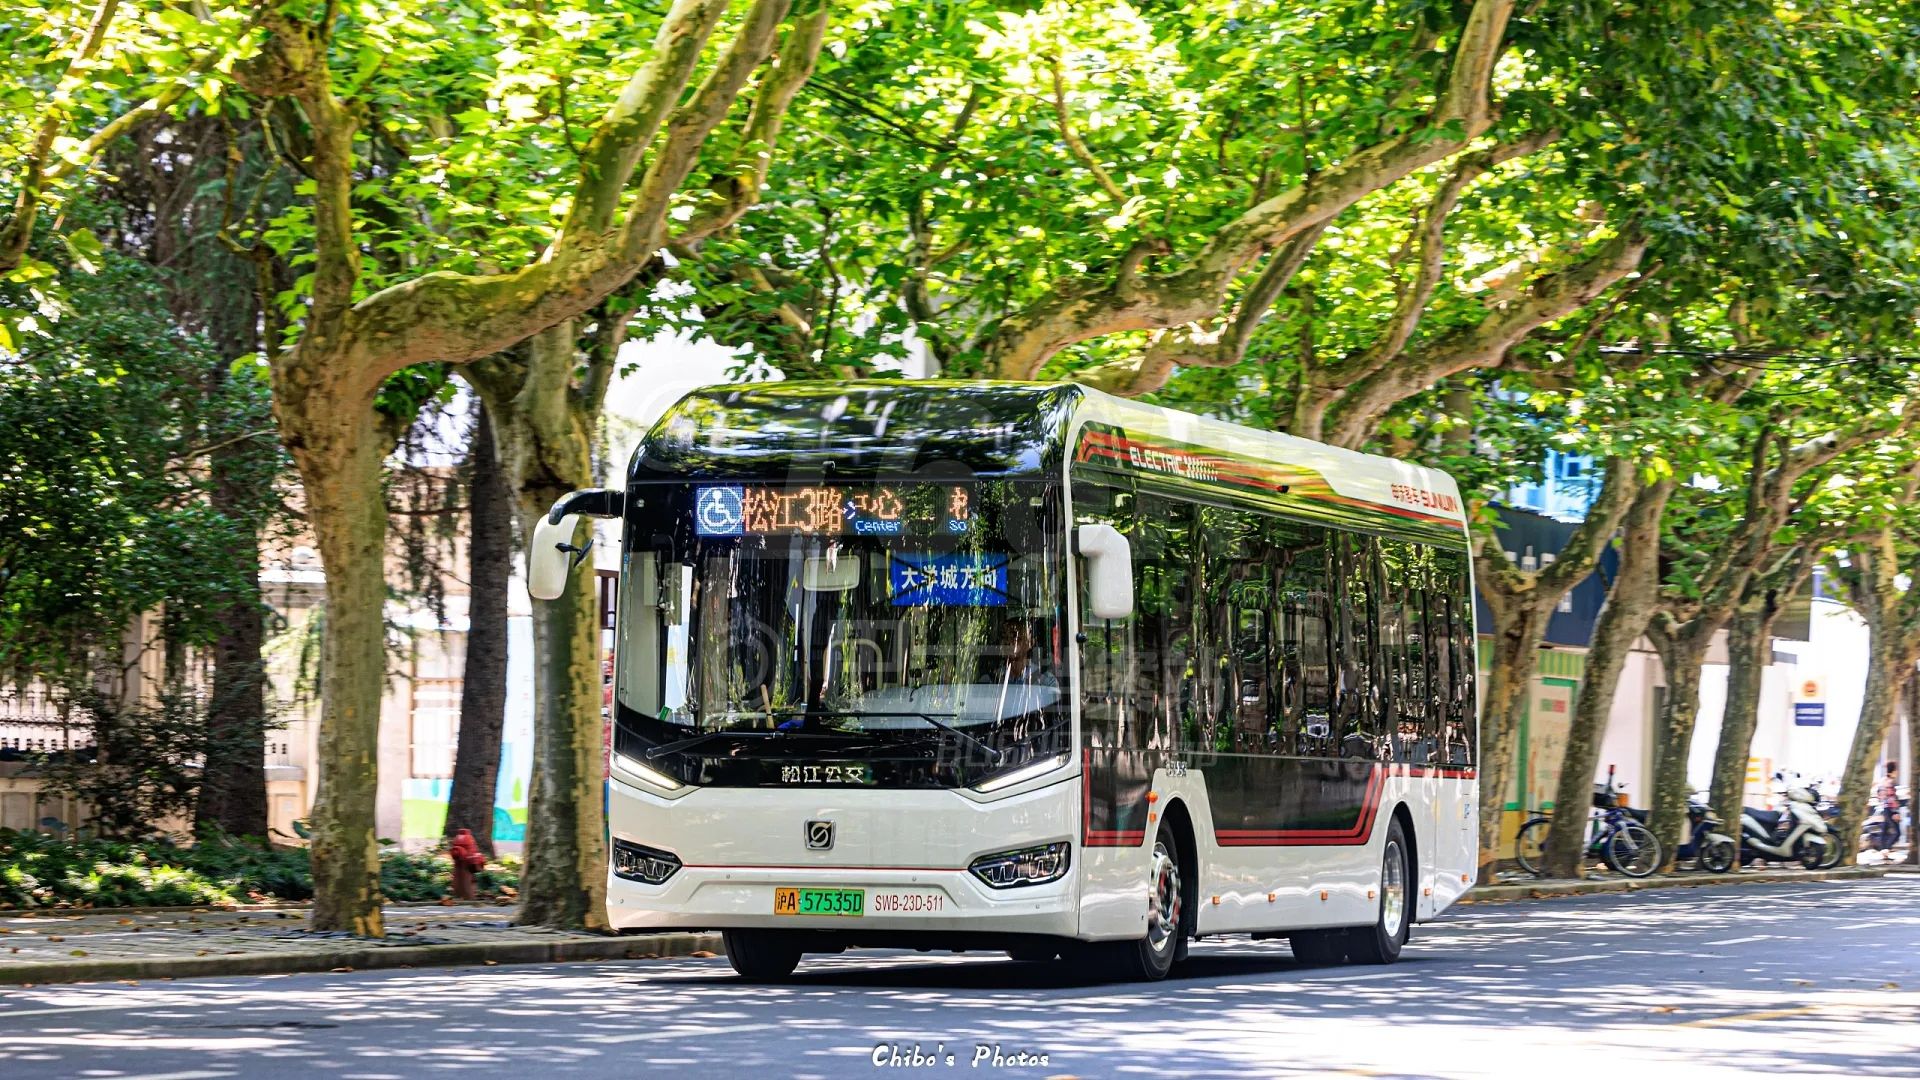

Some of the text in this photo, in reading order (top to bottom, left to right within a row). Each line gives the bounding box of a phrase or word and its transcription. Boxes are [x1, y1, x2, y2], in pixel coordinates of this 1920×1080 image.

[1129, 446, 1185, 475] ELECTRIC
[741, 487, 842, 532] 松江3路
[901, 564, 997, 590] 大学城方向
[781, 764, 865, 784] 松江公交
[874, 894, 944, 912] SWB-23D-511
